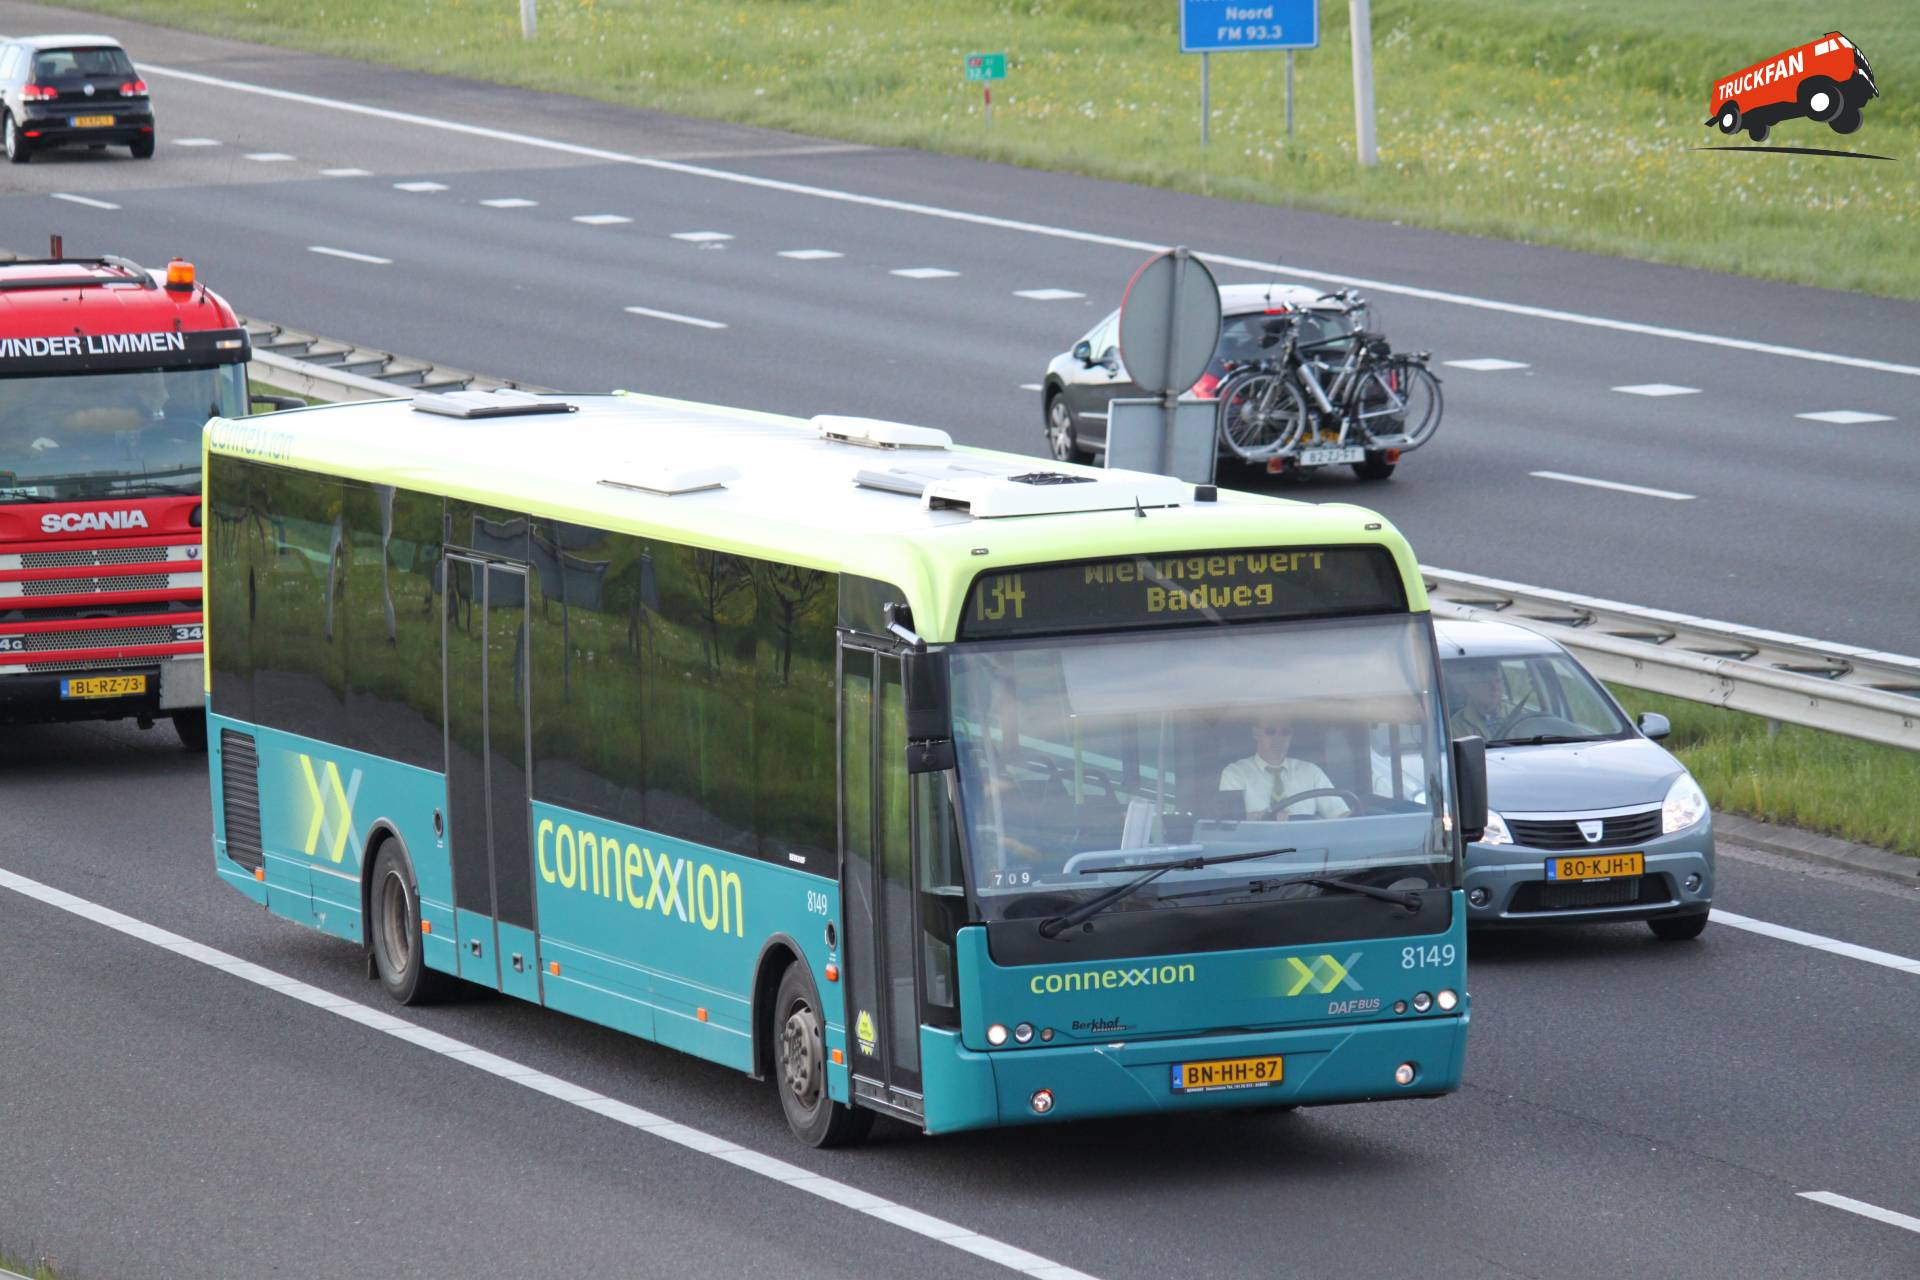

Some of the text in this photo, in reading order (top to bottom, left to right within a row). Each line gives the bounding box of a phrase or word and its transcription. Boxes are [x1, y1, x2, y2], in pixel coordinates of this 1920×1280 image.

[1225, 5, 1273, 20] Noord
[1217, 25, 1282, 40] FM 93.3
[87, 332, 185, 354] LIMMEN
[41, 510, 148, 533] SCANIA
[1146, 583, 1273, 612] Badweg
[75, 678, 140, 695] BL-RZ-73
[537, 819, 744, 938] connexxion
[1563, 857, 1635, 877] 80-KJH-1
[807, 890, 828, 916] 8149
[1401, 944, 1456, 969] 8149
[1030, 964, 1195, 994] connexxion
[1071, 1016, 1120, 1033] Berkhof
[1188, 1060, 1278, 1084] BN-HH-87
